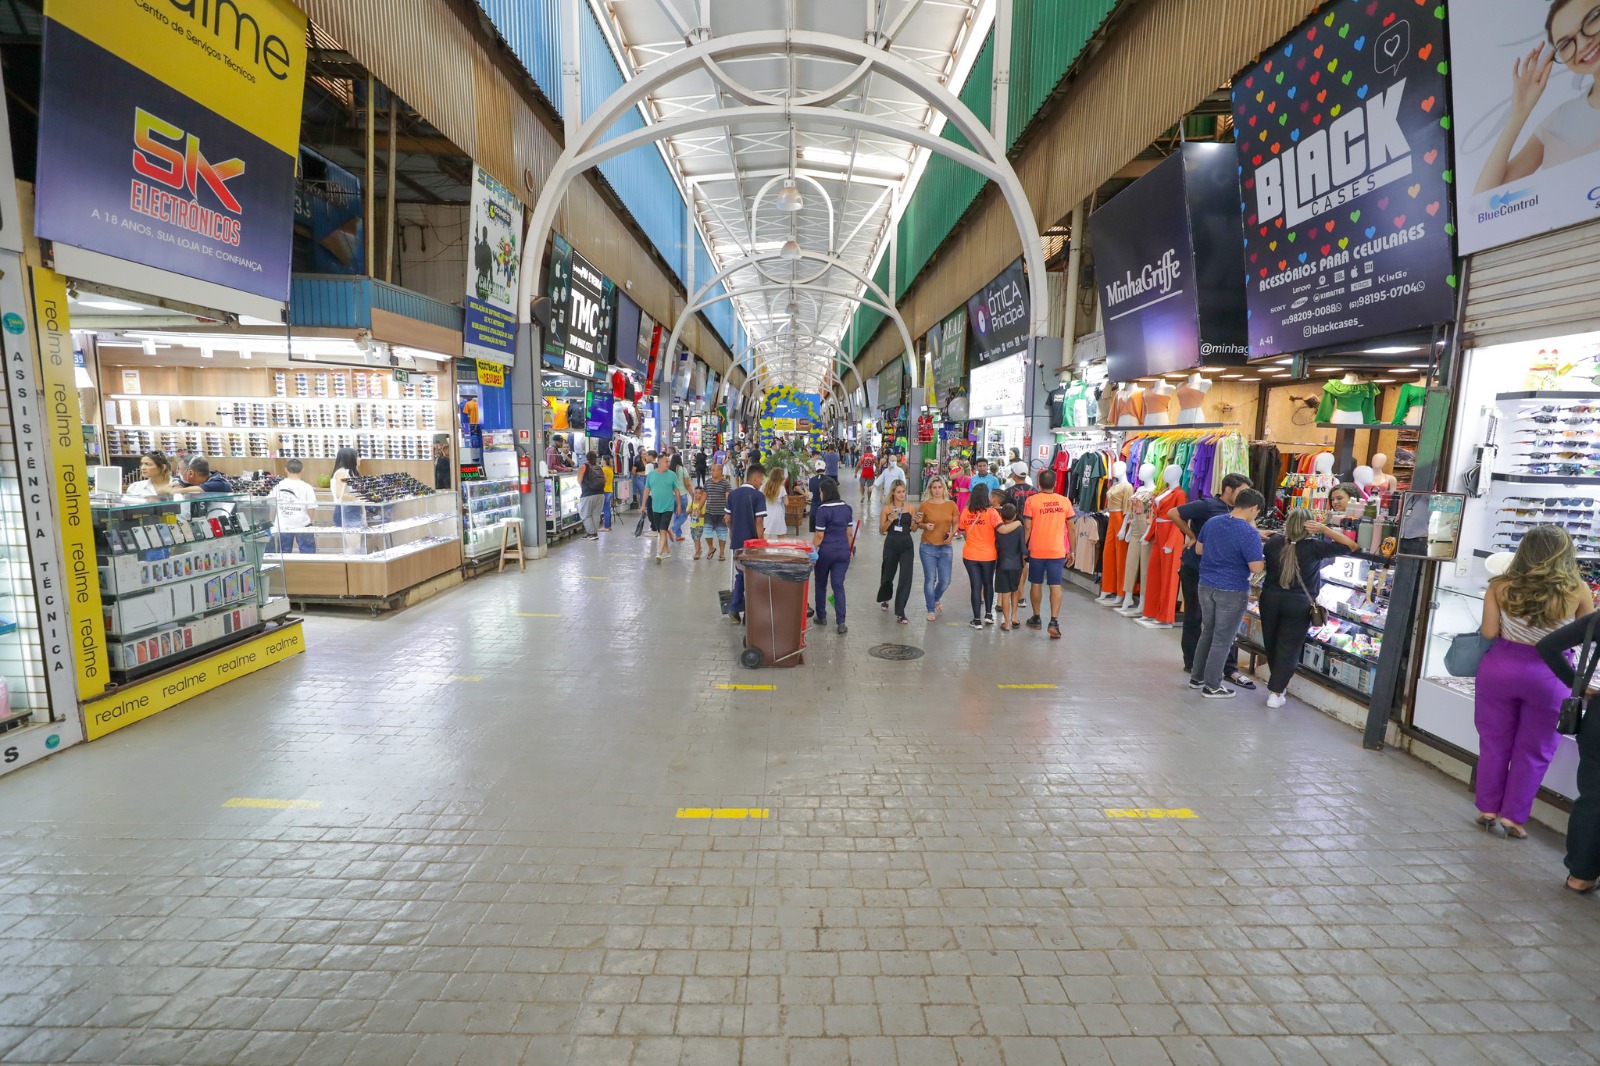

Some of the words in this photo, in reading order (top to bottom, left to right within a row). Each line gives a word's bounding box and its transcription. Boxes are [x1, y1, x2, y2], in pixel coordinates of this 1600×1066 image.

[134, 0, 169, 25] Centro
[171, 20, 184, 36] de
[186, 29, 221, 61] Serviços
[223, 53, 256, 84] Técnicos
[132, 106, 246, 215] SK
[1254, 76, 1412, 229] BLACK
[130, 178, 241, 247] ELECTRÔNICOS
[1310, 173, 1377, 216] CASES
[1477, 194, 1539, 224] BlueControl
[91, 208, 100, 220] A
[104, 212, 118, 225] 18
[157, 230, 175, 244] SUA
[177, 236, 200, 252] LOJA
[202, 244, 214, 257] DE
[215, 250, 263, 272] CONFIANÇA
[1259, 261, 1317, 292] ACESSÓRIOS
[1319, 249, 1350, 272] PARA
[1352, 222, 1425, 260] CELULARES
[987, 280, 1022, 317] ÓTICA
[1105, 248, 1181, 307] MinhaGriffe
[1292, 282, 1311, 295] Lenovo
[44, 299, 63, 366] realme
[571, 287, 599, 338] TMC
[943, 313, 963, 341] REAL
[991, 299, 1026, 332] Principal
[1270, 303, 1287, 314] SONY
[554, 380, 582, 388] CELL
[53, 383, 73, 448] realme
[62, 464, 80, 527] realme
[71, 542, 89, 604] realme
[40, 562, 64, 672] TÉCNICA
[80, 618, 97, 679] realme
[217, 651, 257, 676] realme
[266, 634, 299, 656] realme
[95, 694, 149, 726] realme
[162, 671, 207, 698] realme
